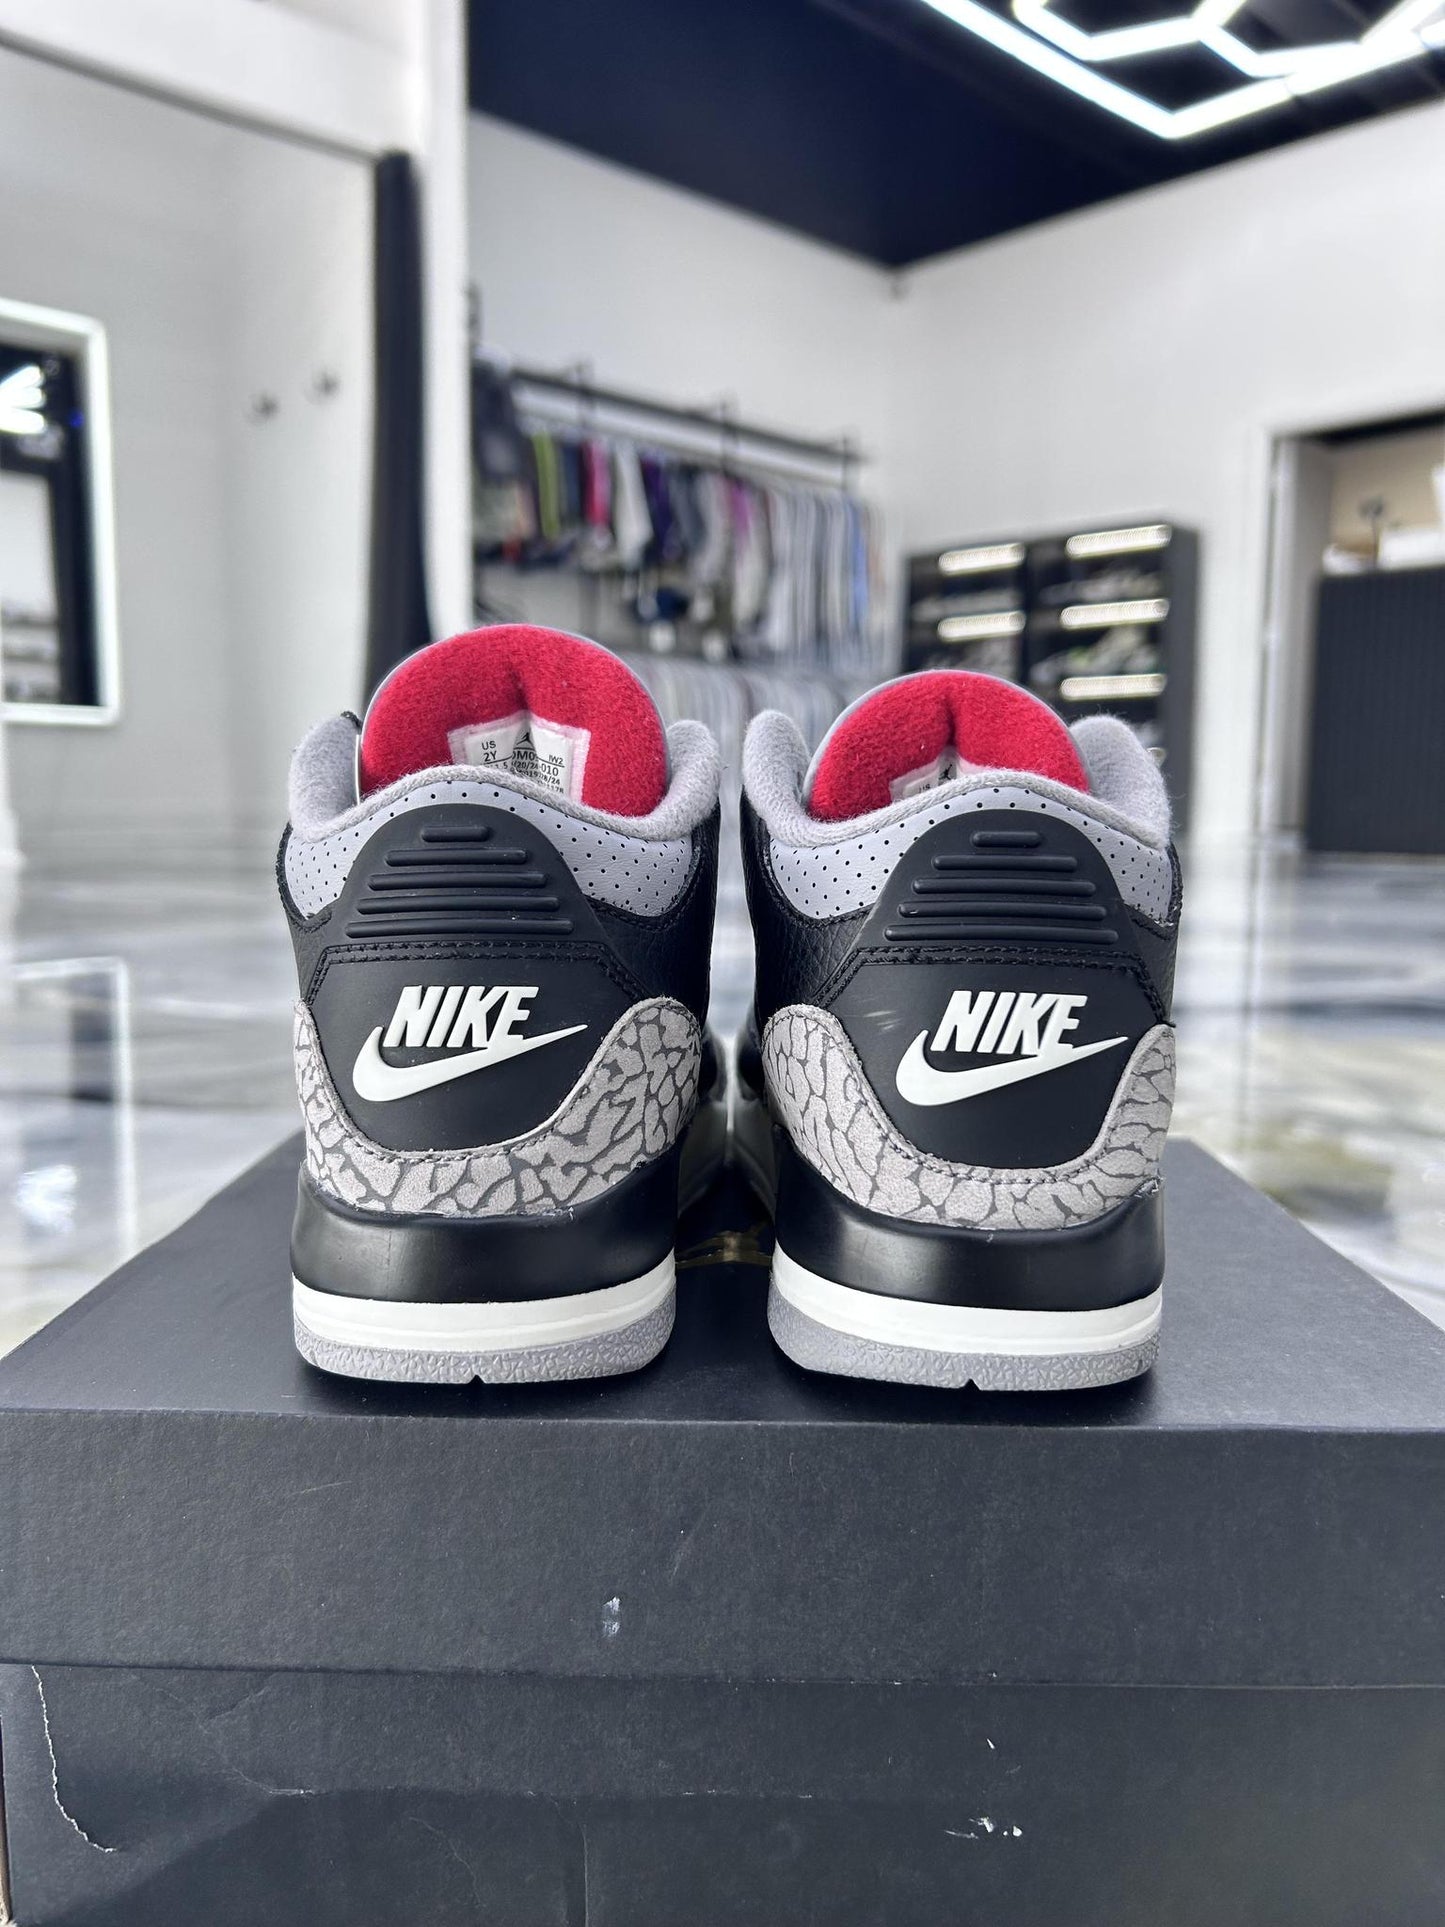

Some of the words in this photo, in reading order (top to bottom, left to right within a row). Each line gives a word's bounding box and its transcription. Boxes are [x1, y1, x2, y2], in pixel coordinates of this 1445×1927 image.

[482, 740, 496, 750] US
[483, 750, 497, 762] 2Y
[382, 985, 540, 1048] NIKE
[930, 990, 1088, 1056] NIKE
